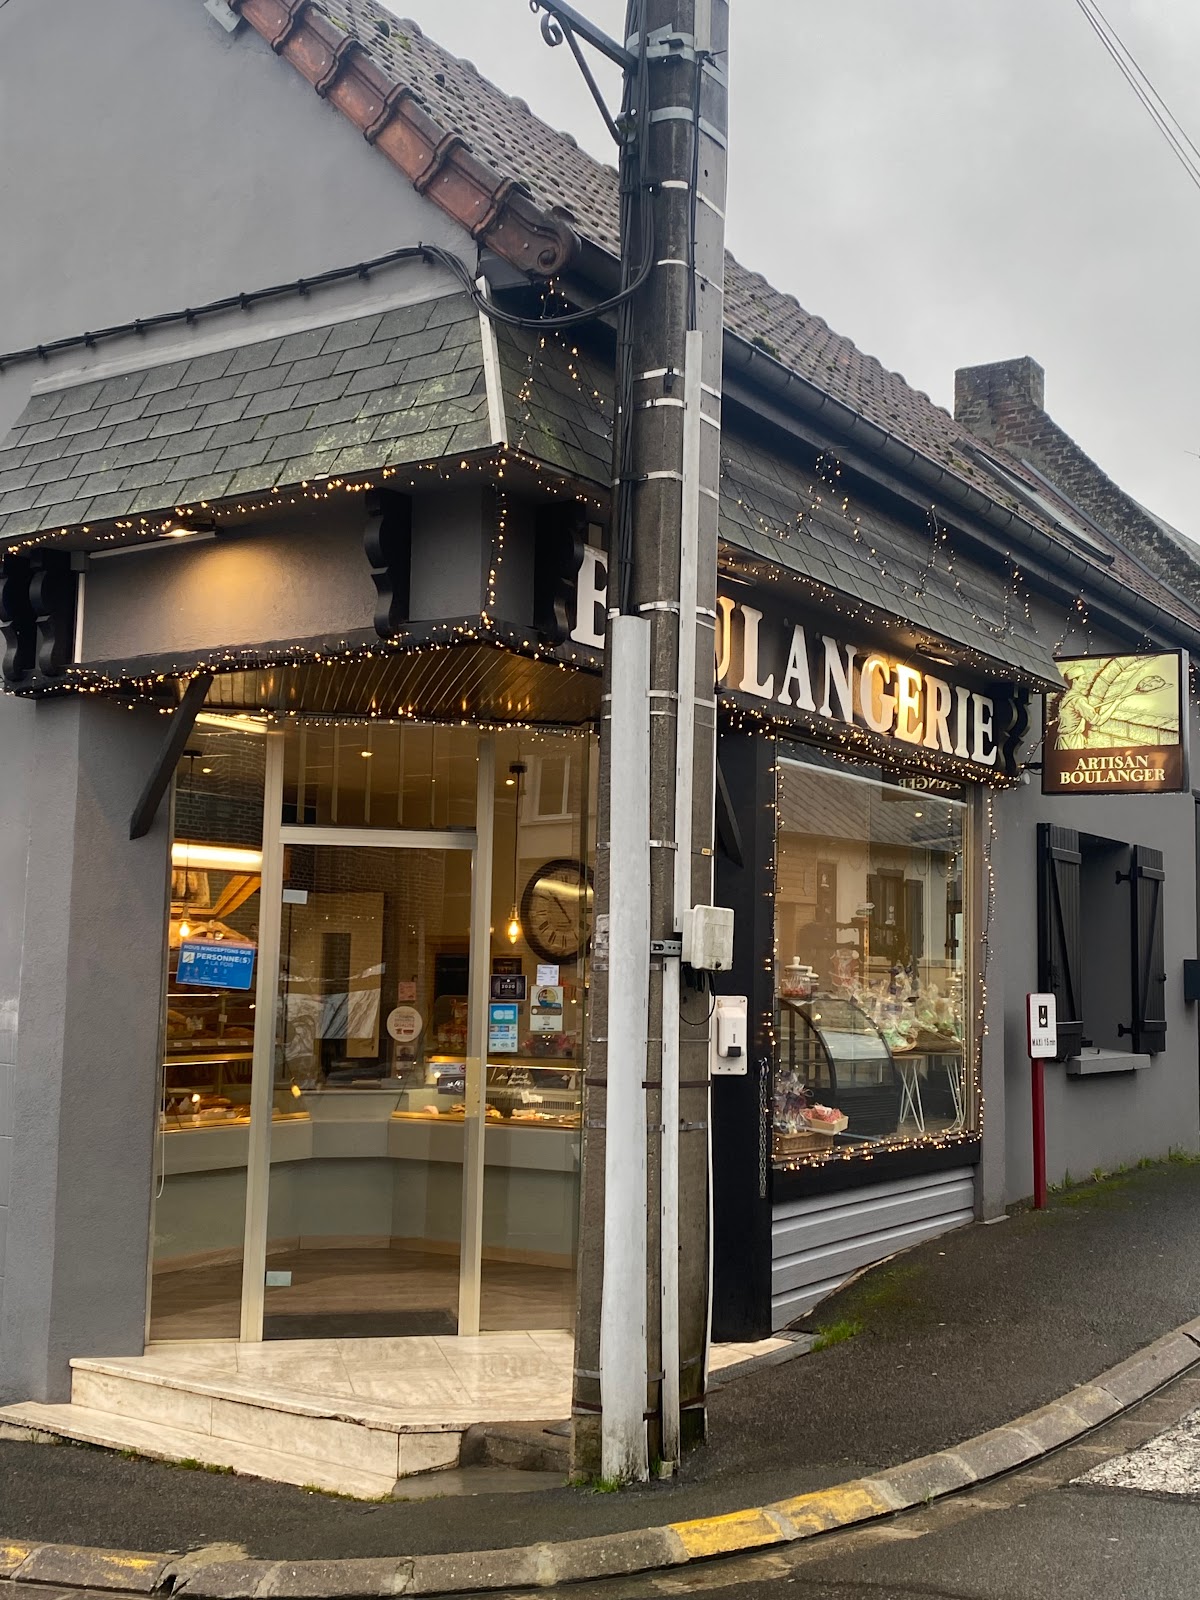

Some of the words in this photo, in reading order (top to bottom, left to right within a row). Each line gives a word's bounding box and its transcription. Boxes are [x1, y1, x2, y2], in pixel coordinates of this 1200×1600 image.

[570, 543, 998, 766] BLANGERIE
[1075, 755, 1149, 770] ARTISAN
[1060, 768, 1165, 785] BOULANGER
[196, 952, 251, 965] PERSONNE(S)
